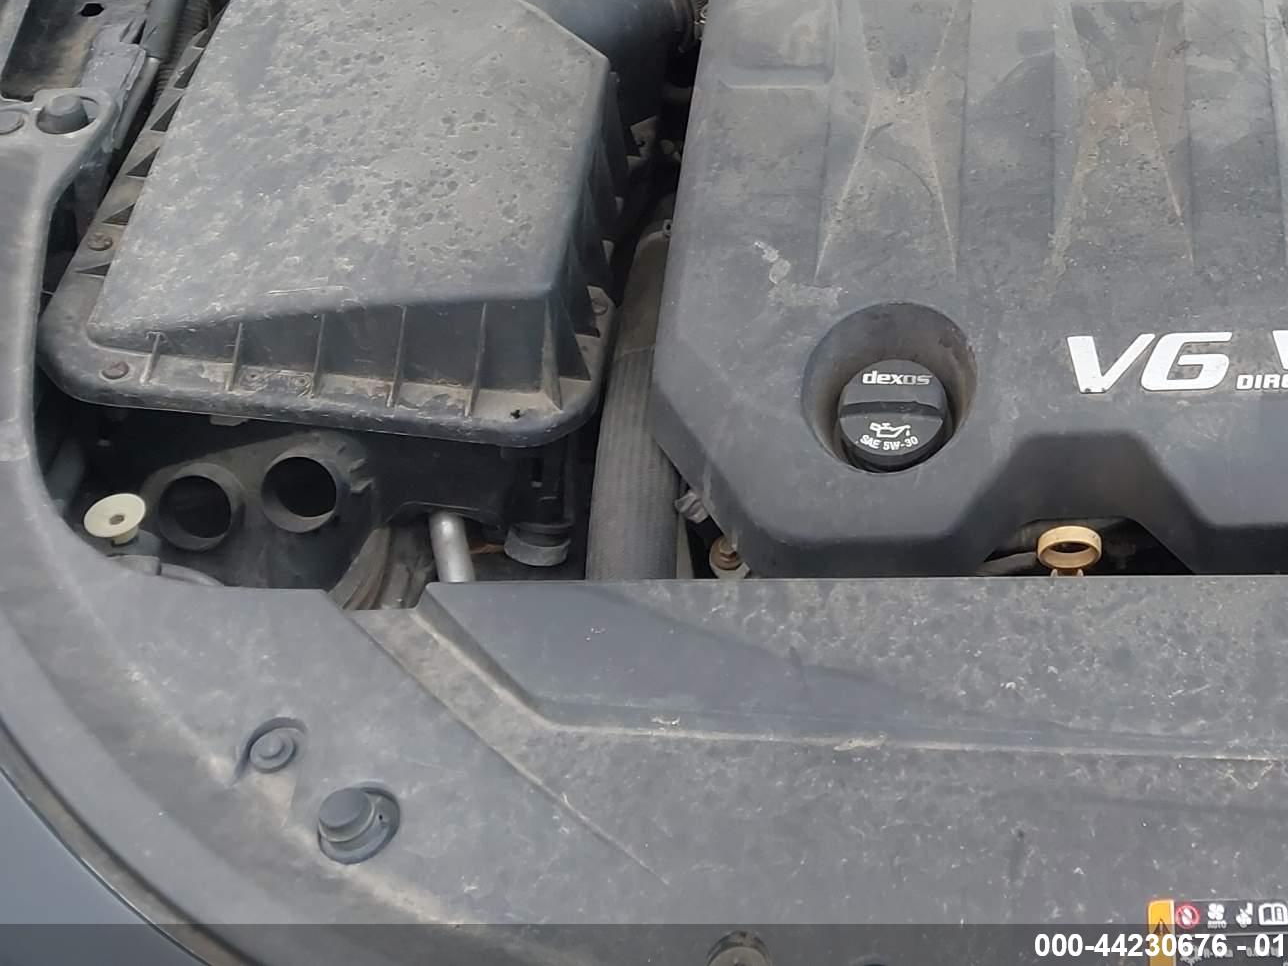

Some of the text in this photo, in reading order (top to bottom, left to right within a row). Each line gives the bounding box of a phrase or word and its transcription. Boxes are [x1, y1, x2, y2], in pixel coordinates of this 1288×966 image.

[1067, 331, 1233, 395] V6
[862, 370, 933, 386] dexos
[859, 434, 919, 451] SAE 5W-30
